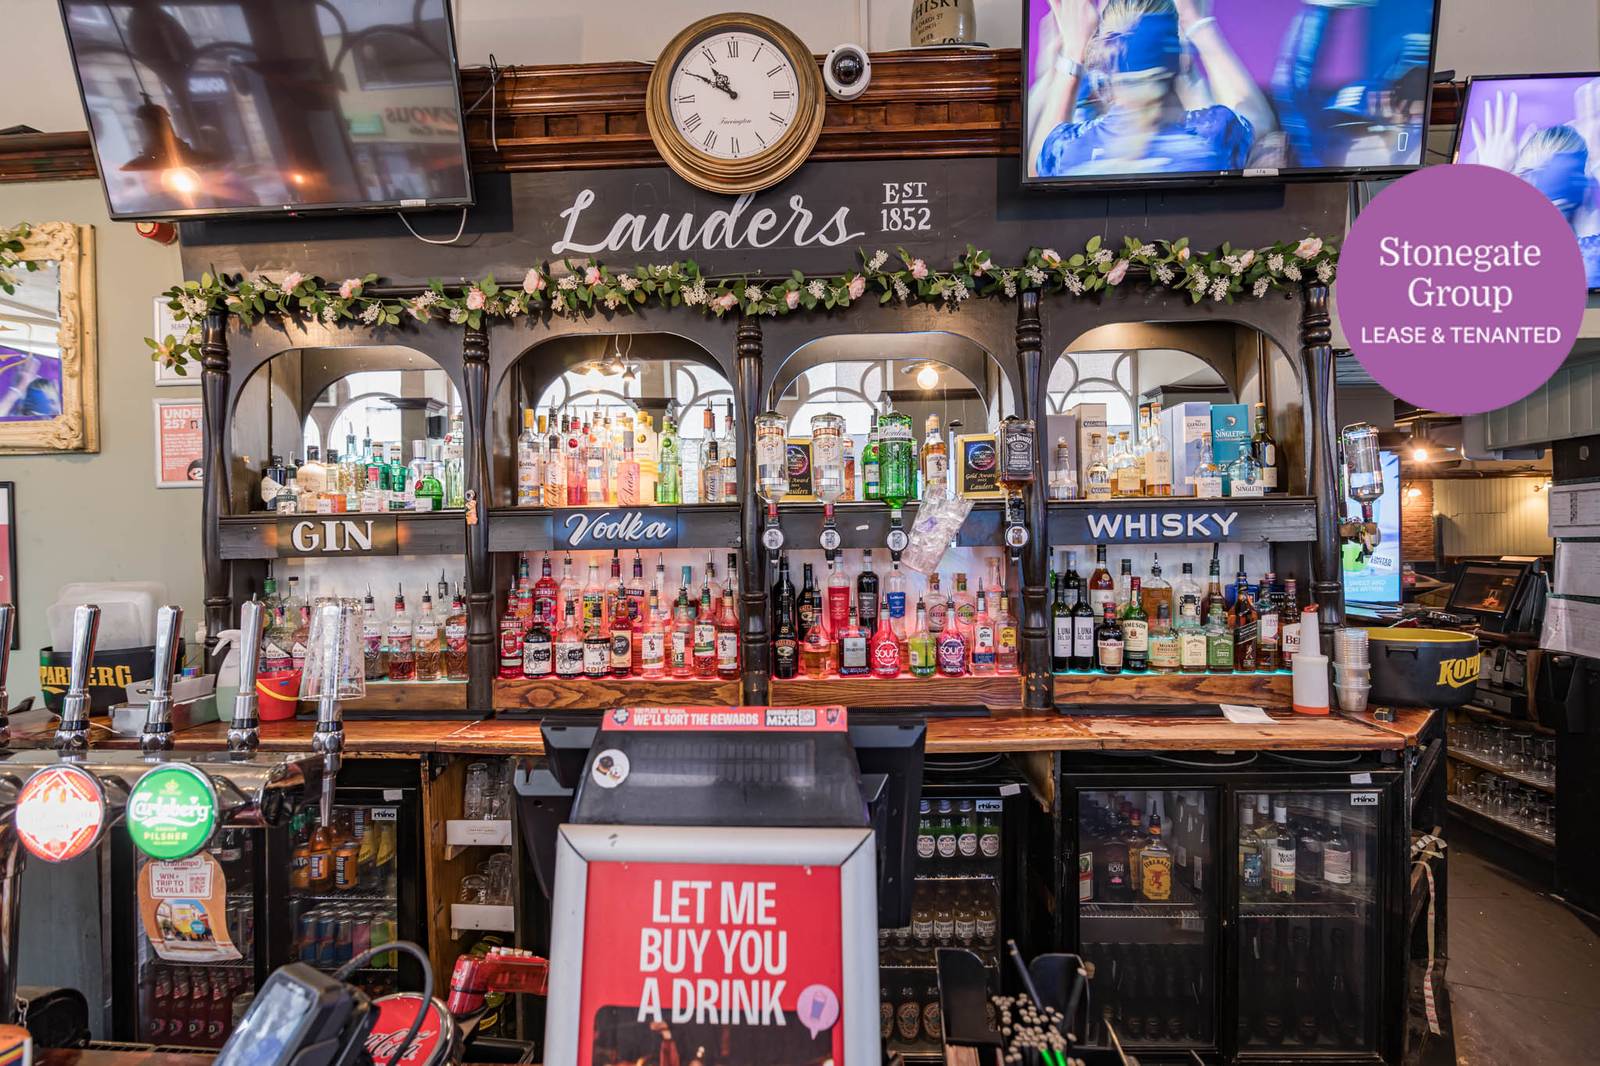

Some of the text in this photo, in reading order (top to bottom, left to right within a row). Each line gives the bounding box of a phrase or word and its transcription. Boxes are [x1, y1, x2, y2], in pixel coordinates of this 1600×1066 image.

[551, 188, 865, 255] Lauders
[880, 208, 931, 232] 1852
[163, 408, 202, 419] UNDE
[293, 520, 374, 552] GIN
[565, 512, 672, 546] Vodka
[1088, 512, 1238, 538] WHISKY
[634, 713, 759, 726] WE'LL SORT THE REWARDS
[130, 792, 212, 825] Carlsberg
[978, 801, 1000, 809] rhino
[1353, 794, 1376, 803] rhino
[374, 810, 395, 818] rhino
[652, 880, 776, 925] LET ME
[640, 928, 787, 975] BUY YOU
[637, 977, 787, 1026] A DRINK
